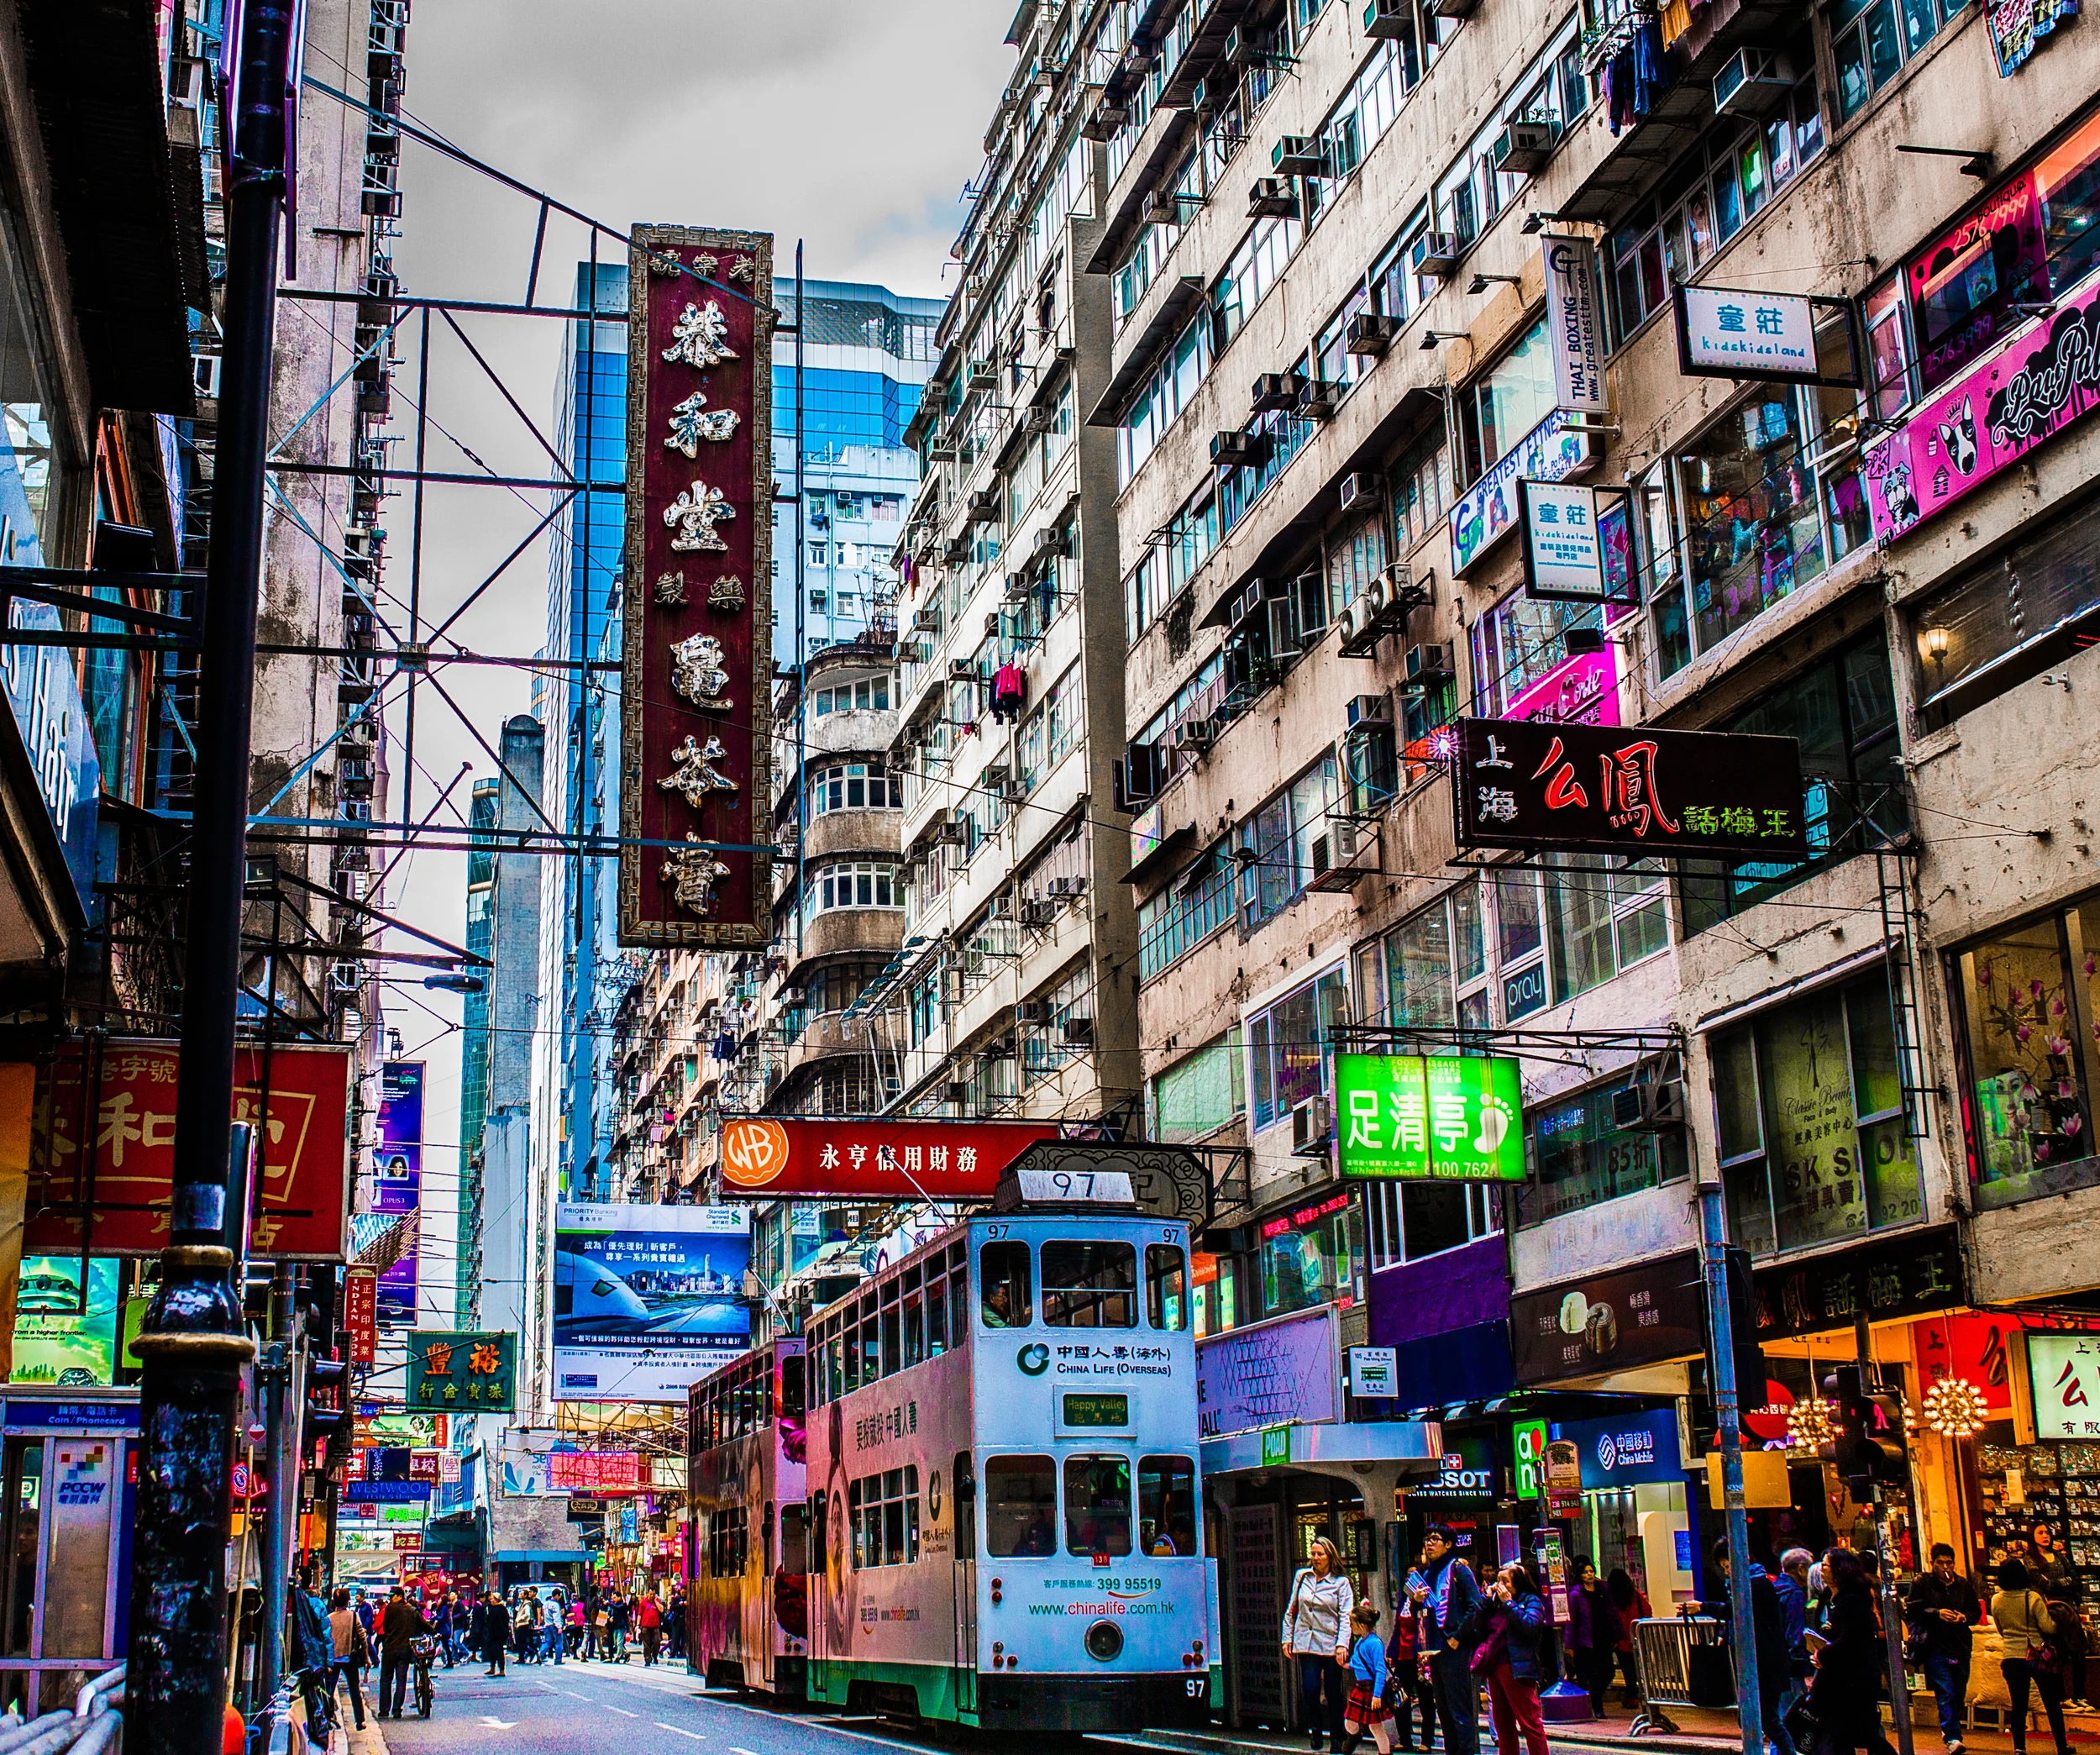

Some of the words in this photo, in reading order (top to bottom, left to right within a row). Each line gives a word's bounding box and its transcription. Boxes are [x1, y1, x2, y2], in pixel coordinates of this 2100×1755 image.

[1563, 297, 1582, 353] BOXING
[1717, 304, 1783, 334] 童莊
[1702, 336, 1805, 358] kidskidsland
[1570, 361, 1587, 400] THAI
[1477, 448, 1521, 499] GREATEST
[1538, 503, 1587, 525] 童莊
[1535, 529, 1594, 541] kidskidsland
[1476, 734, 1518, 822] 上海
[1683, 806, 1797, 837] 話梅王
[1507, 969, 1543, 1015] pray
[1347, 1090, 1468, 1153] 足清亭
[820, 1143, 979, 1173] 永亨信用財務
[1608, 1134, 1649, 1175] 85折
[1424, 1161, 1459, 1177] 8100
[1463, 1162, 1498, 1178] 7624
[1053, 1173, 1095, 1198] 97
[988, 1224, 1010, 1240] 97
[1163, 1228, 1179, 1243] 97
[350, 1279, 360, 1320] INDIAN
[360, 1285, 371, 1356] 正宗印度菜
[1057, 1345, 1171, 1361] 中國人壽(海外)
[2076, 1342, 2100, 1355] 上
[1057, 1363, 1090, 1374] CHINA
[1094, 1363, 1115, 1374] LIFE
[1116, 1363, 1172, 1378] (OVERSEAS)
[2053, 1359, 2100, 1408] 么
[1067, 1399, 1097, 1411] Happy
[1100, 1399, 1127, 1411] Valley
[886, 1400, 917, 1442] 中國人壽
[1265, 1430, 1287, 1458] POAD
[1616, 1431, 1654, 1453] 中國移動
[1618, 1453, 1635, 1465] China
[1635, 1451, 1655, 1463] Mobile
[59, 1482, 106, 1493] PCCW
[1097, 1578, 1121, 1589] 399
[1125, 1578, 1162, 1589] 95519
[1028, 1600, 1175, 1615] www.chinalife.com.hk
[1185, 1679, 1205, 1698] 97
